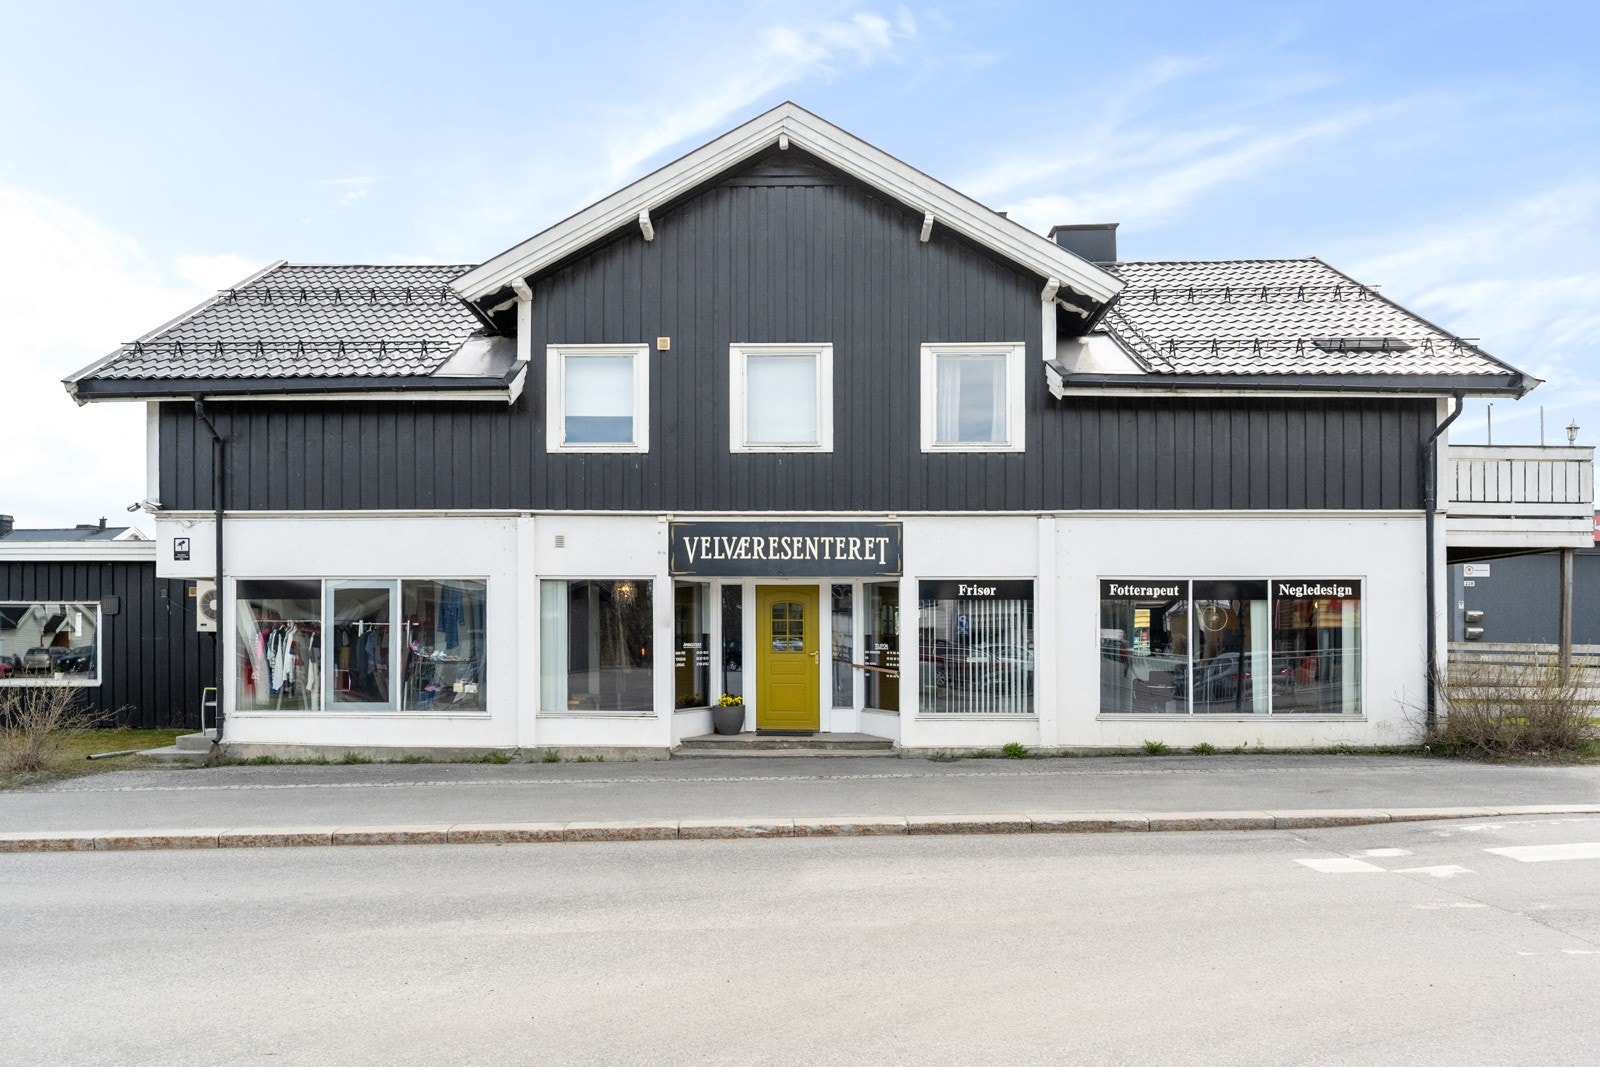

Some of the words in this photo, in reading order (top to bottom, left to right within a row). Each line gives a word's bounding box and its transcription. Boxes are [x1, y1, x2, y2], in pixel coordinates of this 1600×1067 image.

[683, 536, 889, 564] VELVÆRESENTERET
[958, 584, 996, 596] Frisør
[1109, 584, 1179, 598] Fotterapeut
[1279, 584, 1353, 598] Negledesign
